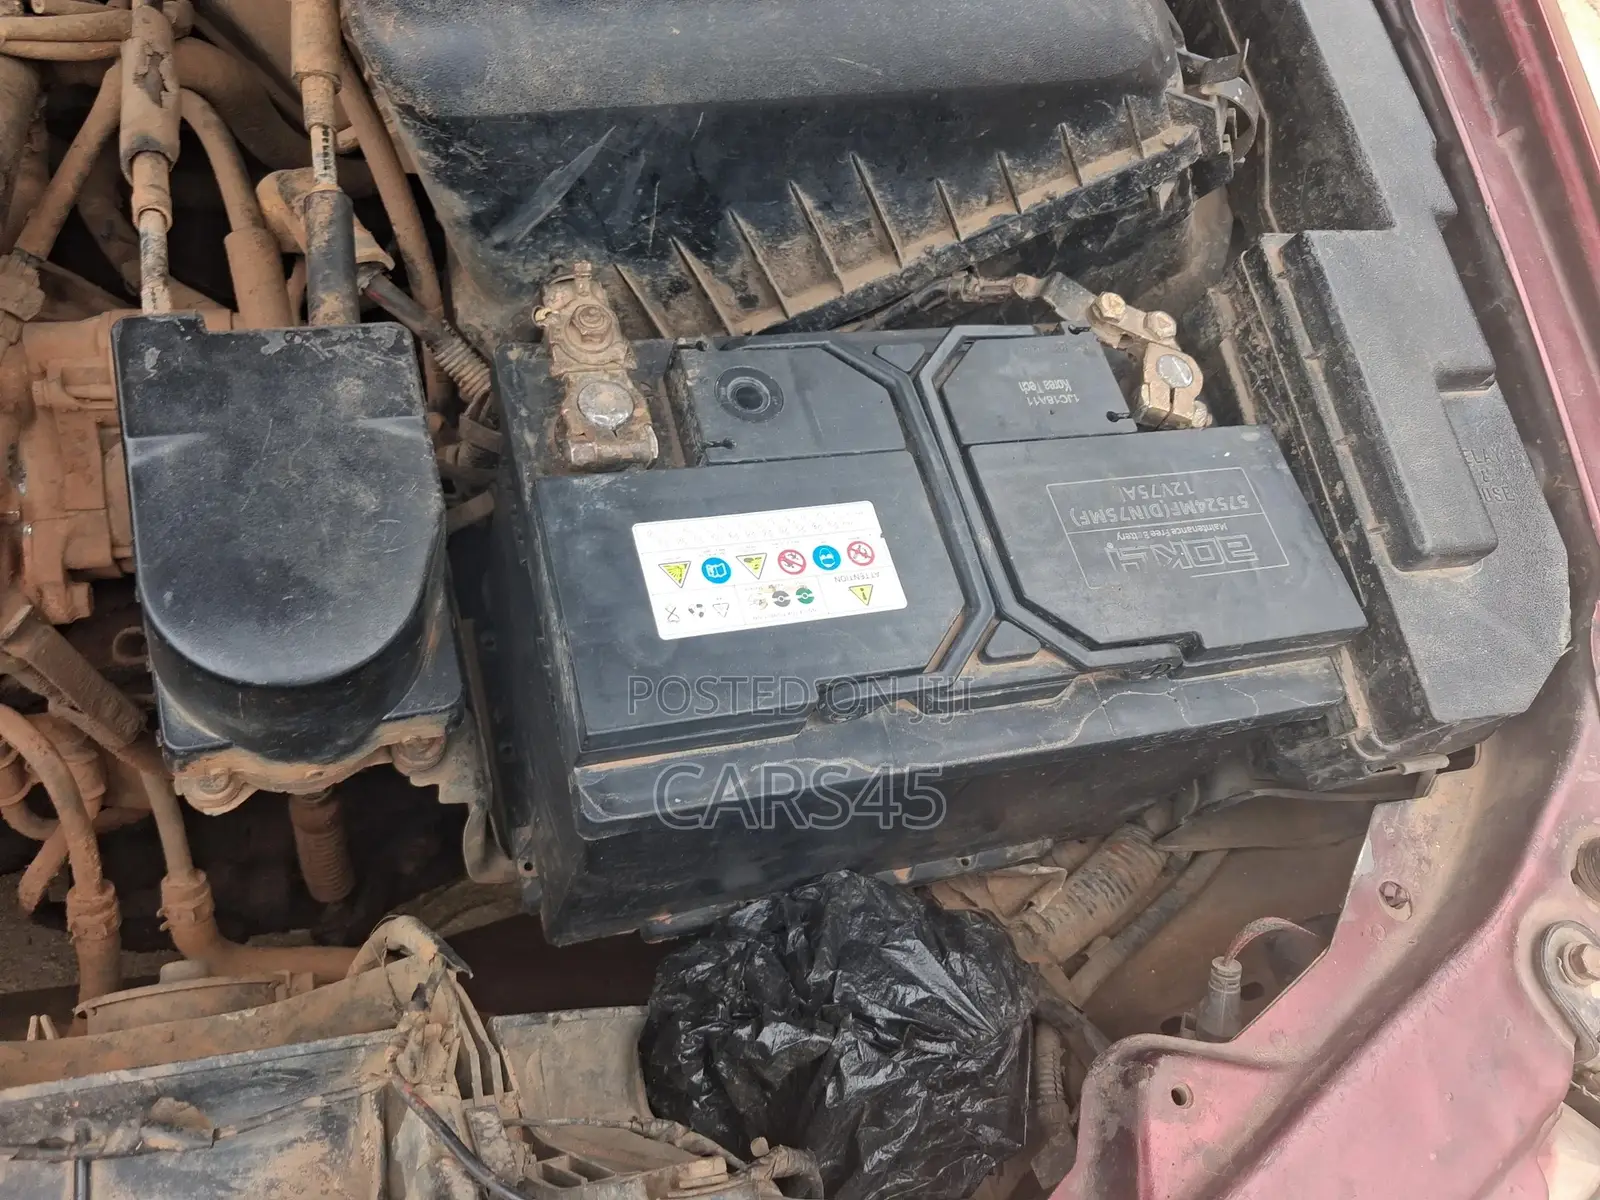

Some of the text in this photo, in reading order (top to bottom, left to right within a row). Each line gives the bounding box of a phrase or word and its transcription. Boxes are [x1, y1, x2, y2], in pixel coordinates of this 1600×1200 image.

[1018, 379, 1072, 394] Korea Tech
[1068, 494, 1250, 527] 57524MF(DIN75MF)
[1150, 528, 1171, 539] Free
[1171, 522, 1228, 537] Maintenance
[834, 570, 881, 584] ATTENTION
